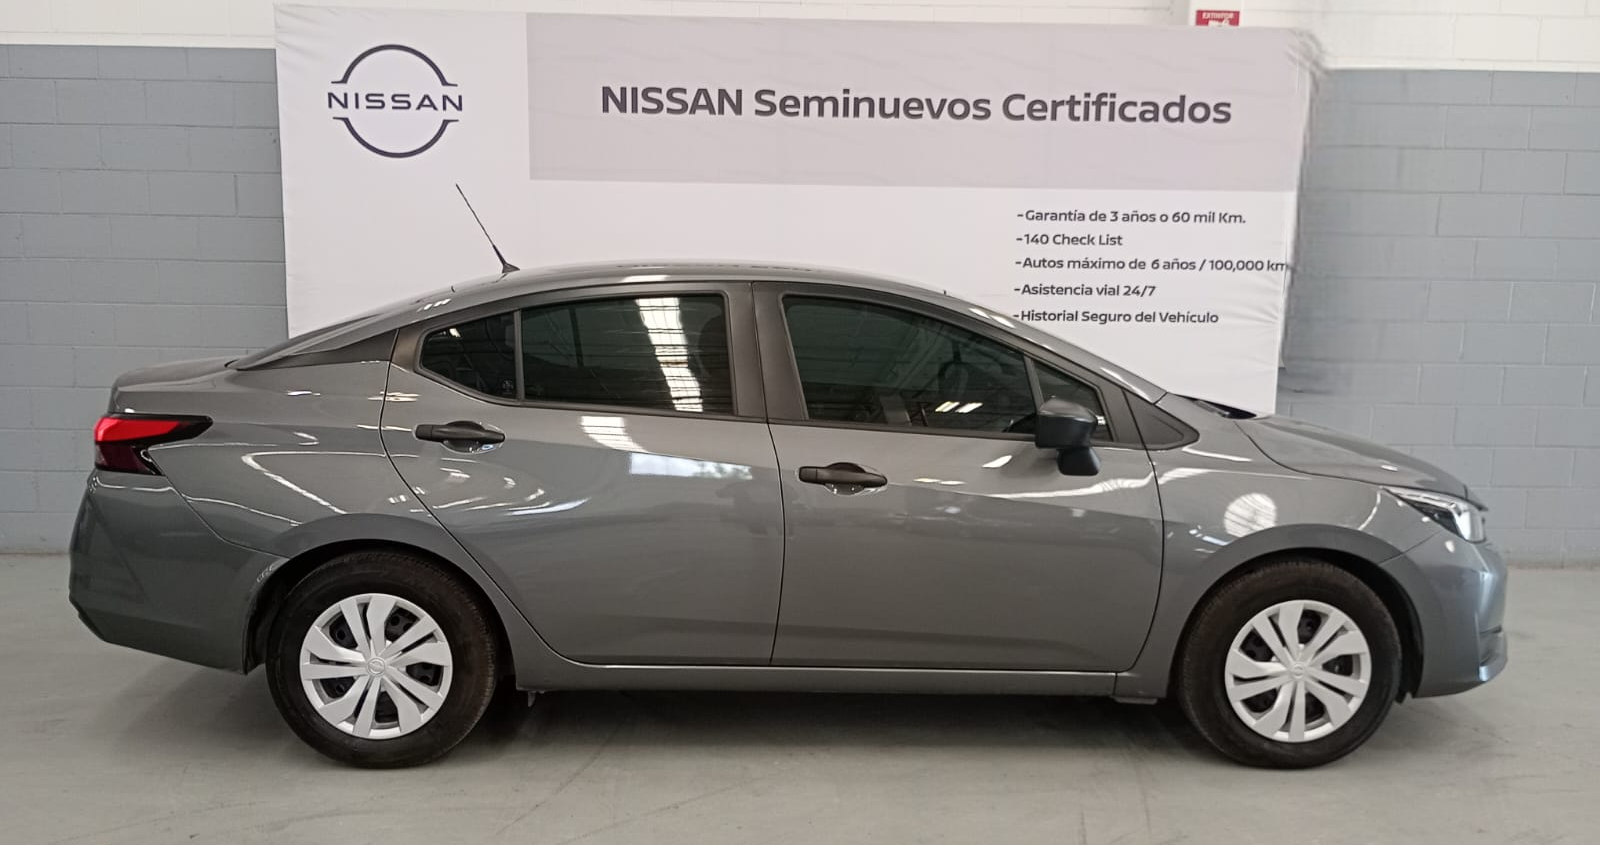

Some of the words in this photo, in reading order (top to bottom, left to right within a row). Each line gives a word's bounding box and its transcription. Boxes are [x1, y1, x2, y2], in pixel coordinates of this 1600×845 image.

[328, 92, 463, 112] NISSAN
[602, 85, 743, 116] NISSAN
[754, 88, 992, 122] Seminuevos
[1002, 92, 1232, 125] Certificados
[1089, 210, 1107, 223] de
[1110, 211, 1119, 223] 3
[1122, 209, 1157, 223] años
[1160, 213, 1169, 223] o
[1172, 211, 1191, 224] 60
[1194, 210, 1216, 223] mil
[1219, 211, 1247, 224] Km.
[1053, 233, 1096, 246] Check
[1099, 233, 1124, 247] List
[1067, 257, 1126, 270] máximo
[1129, 258, 1147, 270] de
[1150, 258, 1161, 271] 6
[1162, 257, 1197, 271] años
[1199, 258, 1207, 272] /
[1209, 259, 1265, 273] 100,000
[1096, 283, 1121, 297] vial
[1123, 284, 1157, 298] 24/7
[1081, 310, 1132, 325] Seguro
[1135, 310, 1157, 324] del
[1159, 310, 1220, 324] Vehículo
